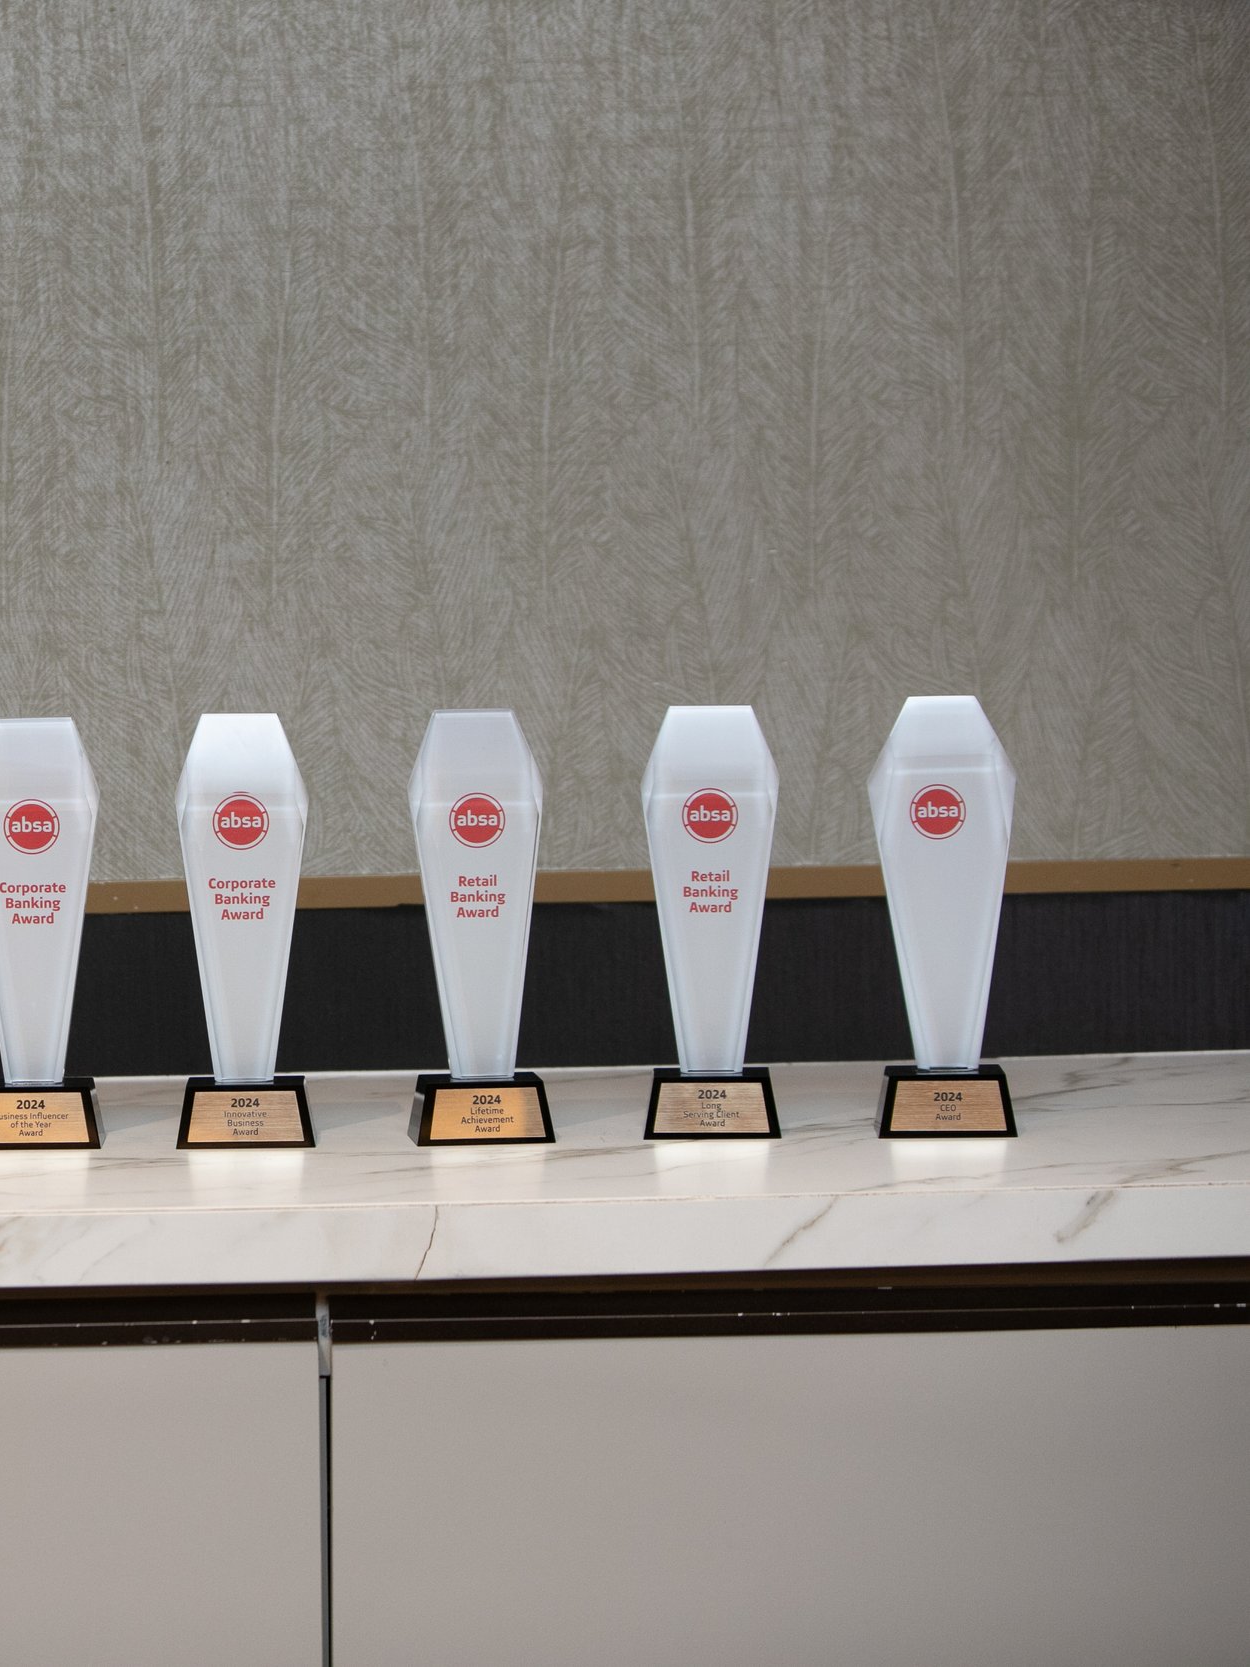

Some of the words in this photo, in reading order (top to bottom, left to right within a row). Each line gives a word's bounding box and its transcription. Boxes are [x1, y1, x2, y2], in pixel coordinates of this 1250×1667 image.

[689, 805, 731, 822] absa
[917, 801, 958, 818] absa
[221, 812, 262, 829] absa
[457, 810, 497, 827] absa
[11, 816, 52, 833] absa
[458, 876, 497, 887] Retail
[691, 871, 730, 882] Retail
[0, 883, 66, 897] Corporate
[208, 879, 275, 893] Corporate
[450, 892, 505, 905] Banking
[683, 887, 737, 901] Banking
[6, 898, 60, 912] Banking
[215, 893, 270, 907] Banking
[457, 907, 499, 918] Award
[690, 902, 730, 913] Award
[13, 913, 55, 925] Award
[222, 908, 264, 920] Award
[697, 1089, 727, 1099] 2024
[933, 1092, 963, 1102] 2024
[16, 1100, 45, 1110] 2024
[230, 1098, 260, 1108] 2024
[472, 1095, 501, 1105] 2024
[470, 1107, 504, 1115] Lifetime
[701, 1102, 722, 1111] Long
[30, 1112, 69, 1120] Influencer
[461, 1116, 514, 1124] Achievement
[683, 1111, 714, 1119] Serving
[716, 1110, 740, 1118] Client
[935, 1113, 961, 1121] Award
[232, 1128, 259, 1136] Award
[474, 1125, 501, 1133] Award
